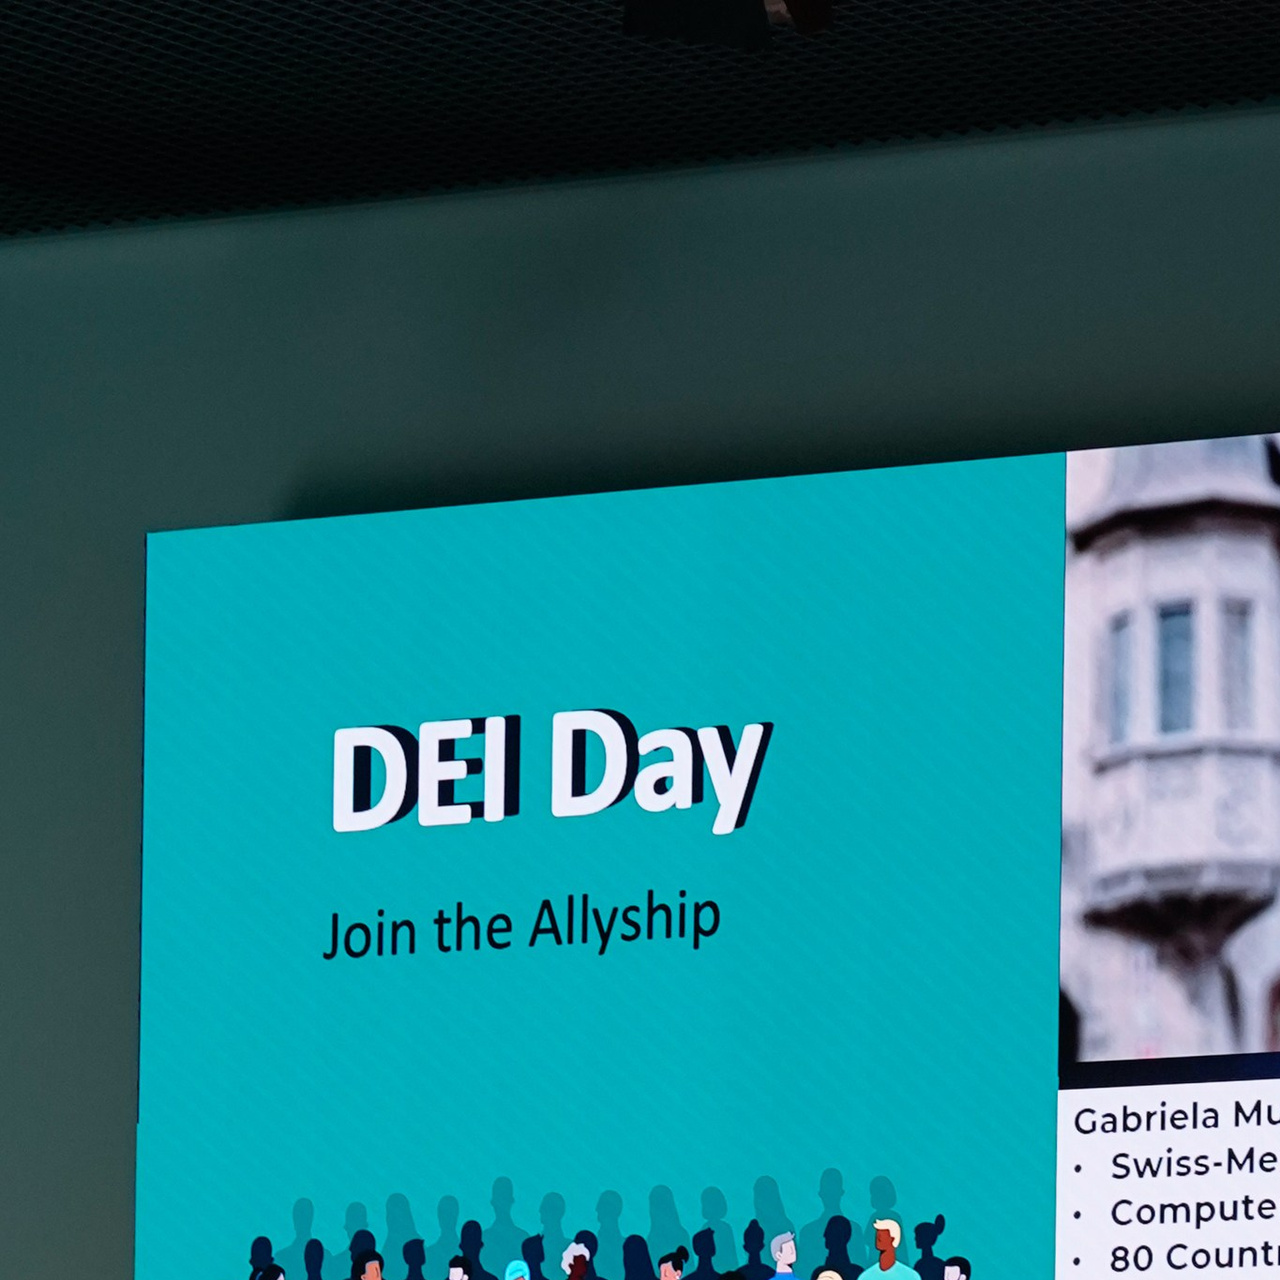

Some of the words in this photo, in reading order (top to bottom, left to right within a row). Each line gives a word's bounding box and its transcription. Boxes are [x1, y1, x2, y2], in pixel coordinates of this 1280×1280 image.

[334, 716, 513, 832] DEI
[552, 710, 768, 834] Day
[322, 908, 416, 960] Join
[433, 901, 514, 953] the
[528, 888, 721, 956] Allyship
[1074, 1100, 1219, 1135] Gabriela
[1110, 1244, 1154, 1273] 80
